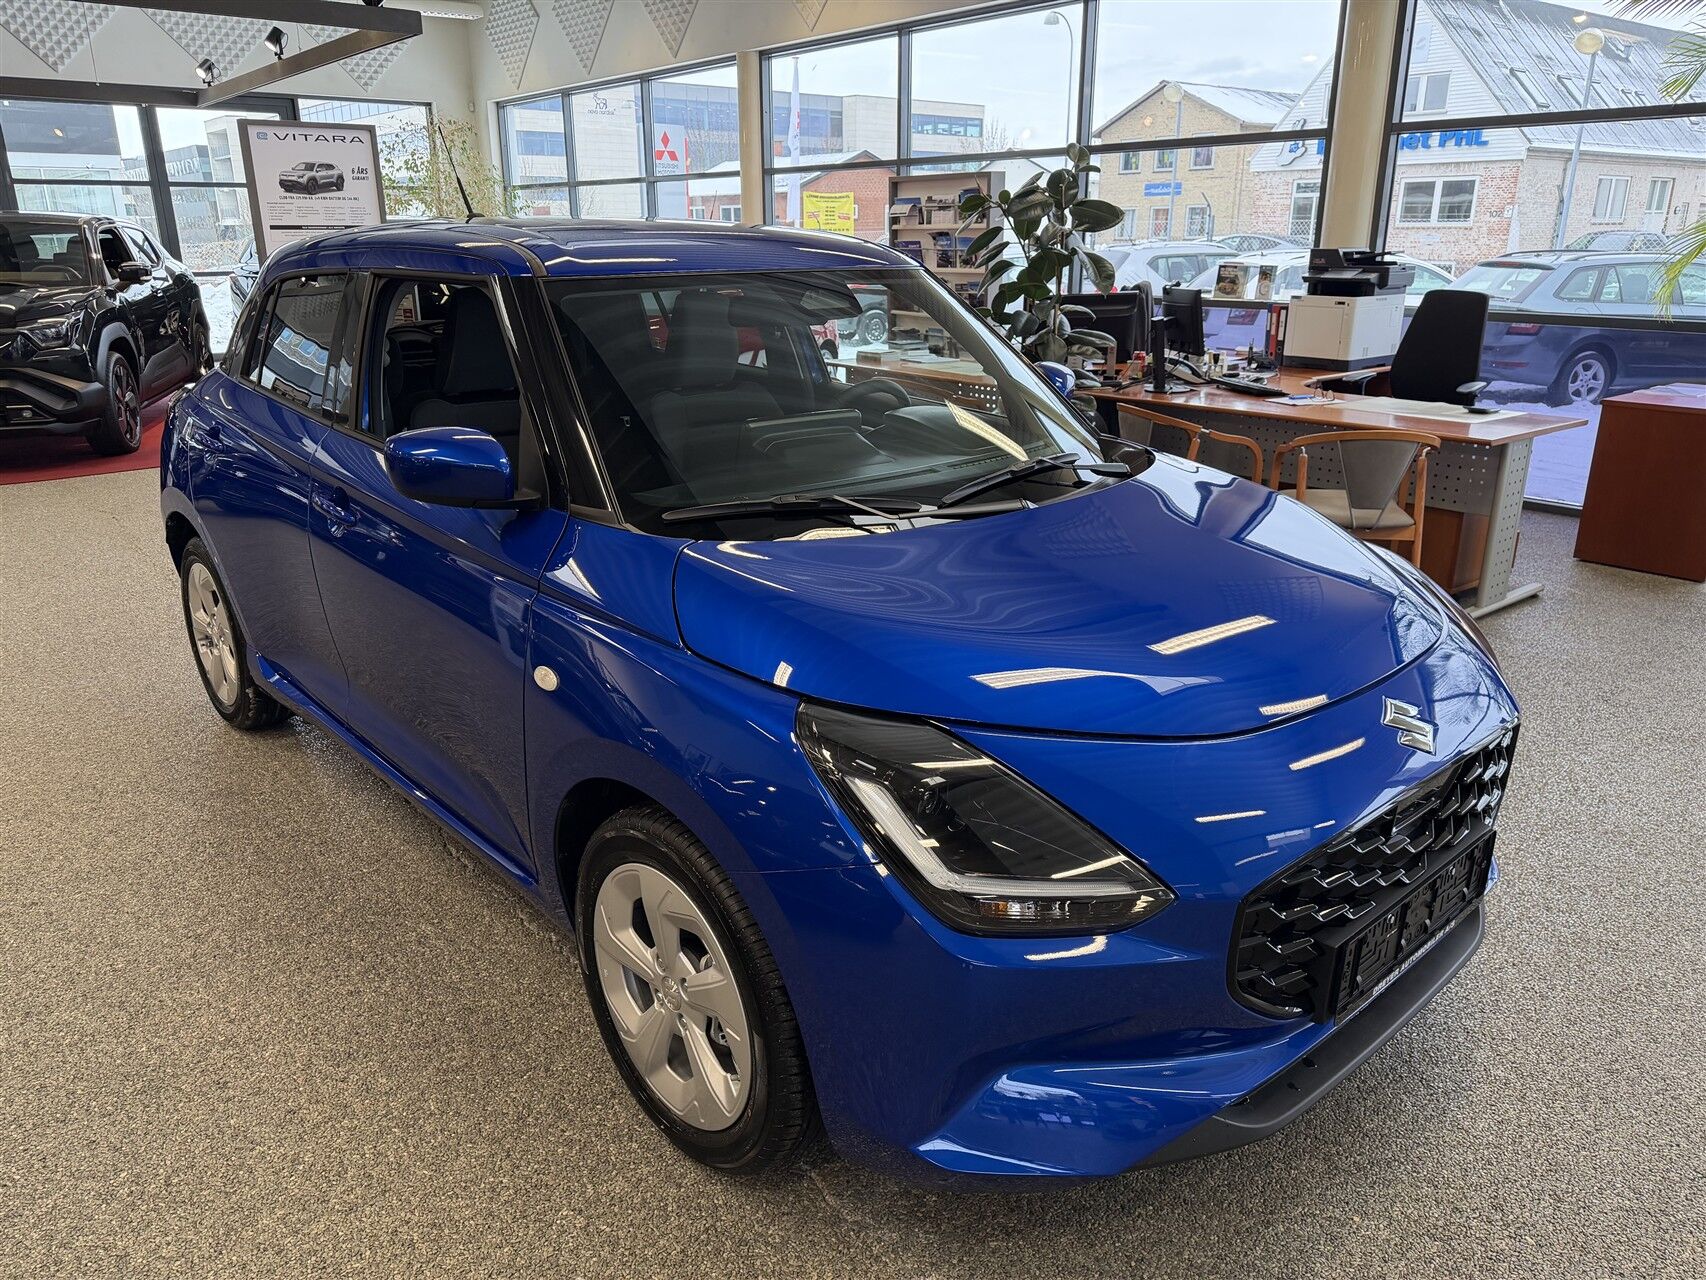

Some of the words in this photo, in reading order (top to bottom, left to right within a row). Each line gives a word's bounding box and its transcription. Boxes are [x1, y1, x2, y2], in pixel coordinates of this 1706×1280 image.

[273, 132, 365, 144] VITARA
[1438, 129, 1490, 148] PHL
[352, 167, 356, 175] 6
[356, 165, 369, 175] ÅRS
[1488, 210, 1504, 218] 102
